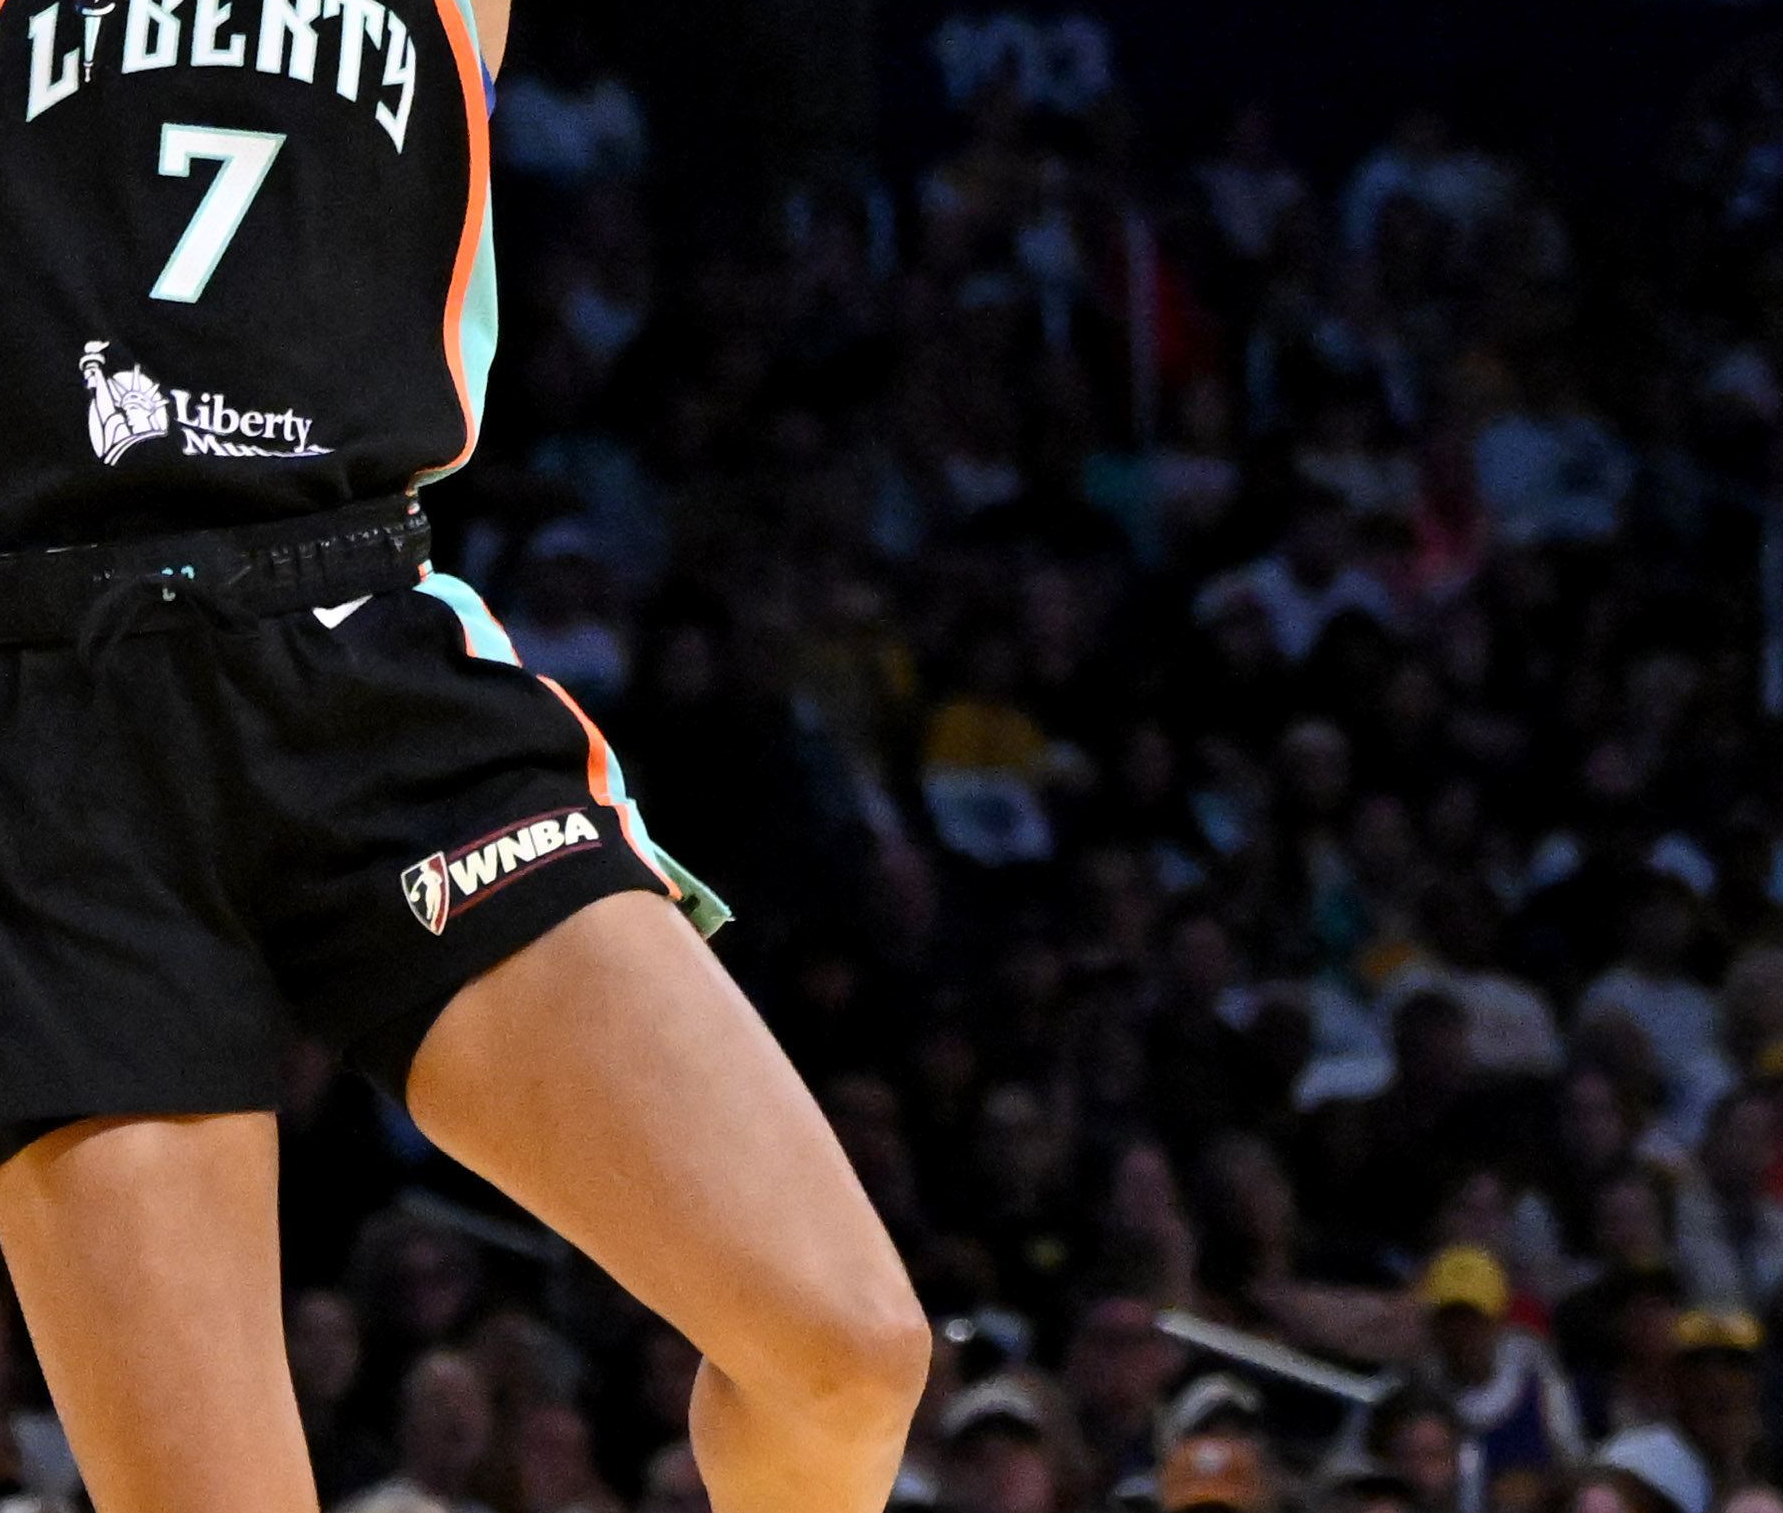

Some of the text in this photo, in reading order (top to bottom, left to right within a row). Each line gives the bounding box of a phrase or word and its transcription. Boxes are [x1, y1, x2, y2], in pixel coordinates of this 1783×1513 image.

[148, 122, 287, 304] 7
[170, 389, 313, 453] Liberty
[448, 812, 599, 896] WNBA
